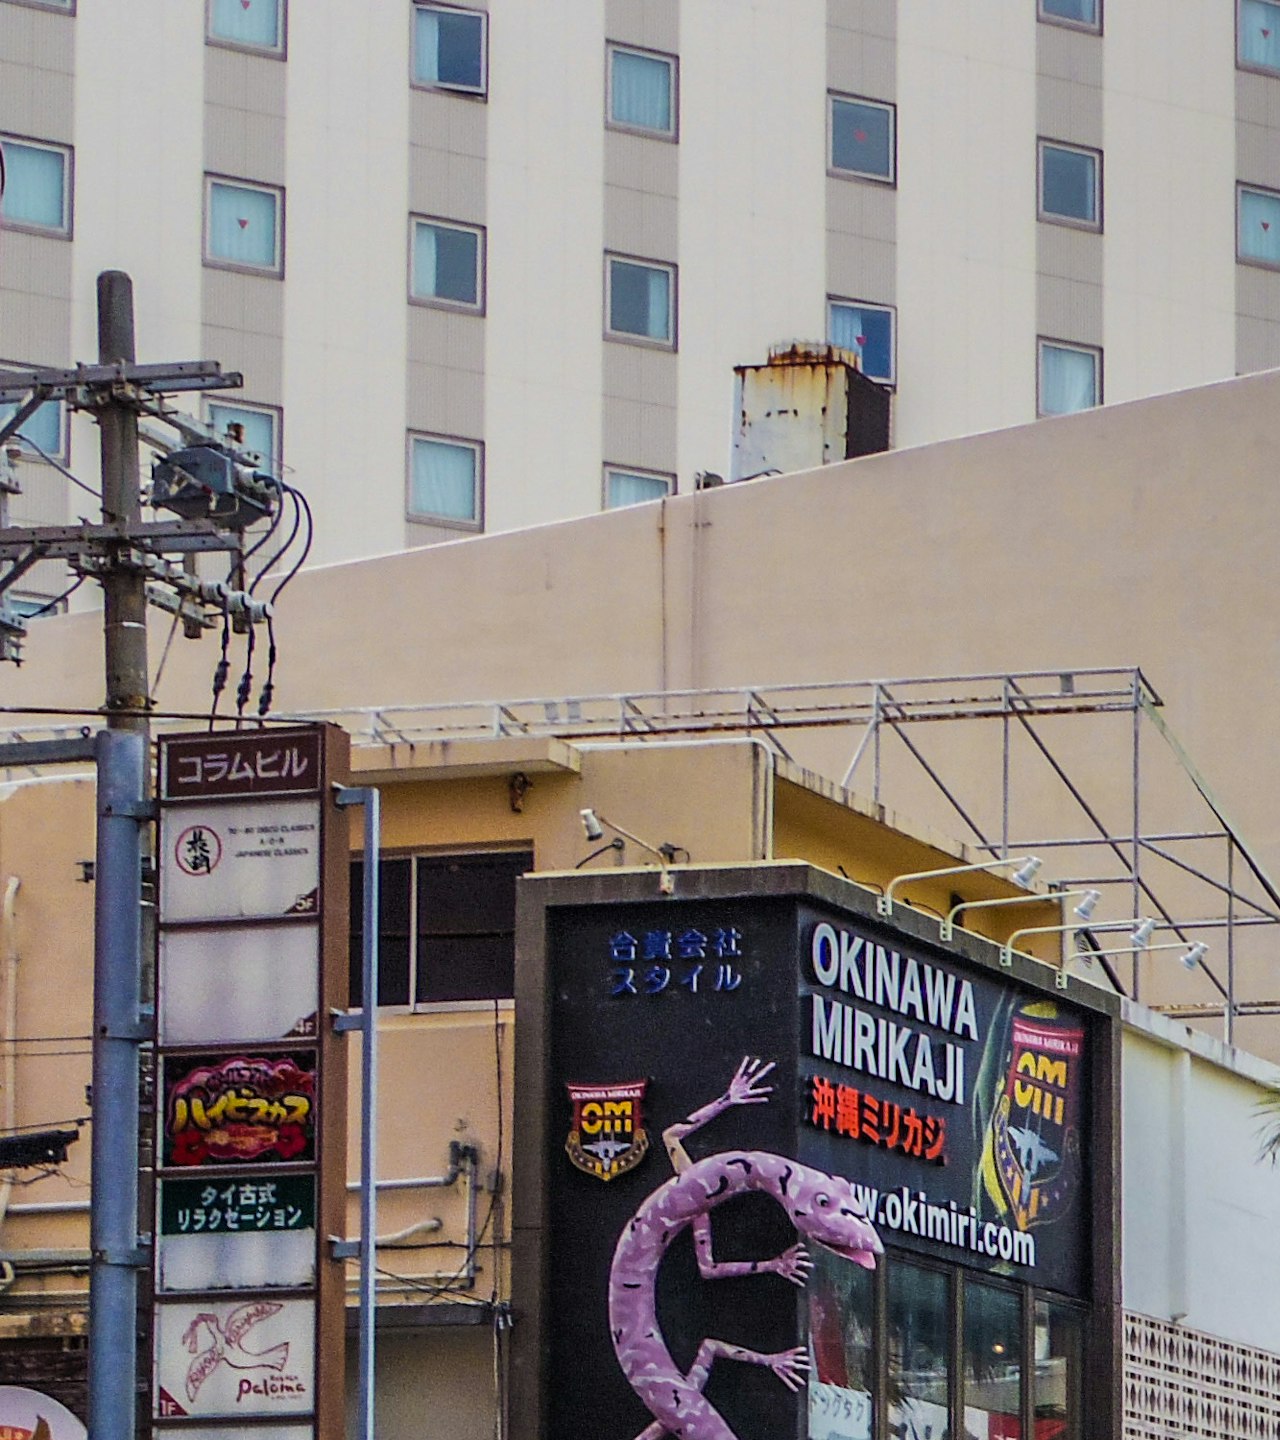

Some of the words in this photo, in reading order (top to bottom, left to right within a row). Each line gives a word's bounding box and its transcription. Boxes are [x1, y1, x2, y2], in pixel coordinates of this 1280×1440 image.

[178, 747, 308, 784] コラムビル
[610, 964, 742, 994] スタイル
[812, 922, 979, 1041] OKINAWA
[812, 993, 964, 1105] MIRIKAJI
[812, 1074, 946, 1160] 沖縄ミリカジ
[200, 1183, 278, 1206] タイ古式
[177, 1204, 302, 1232] リラクゼーション
[236, 1378, 306, 1403] Paloma
